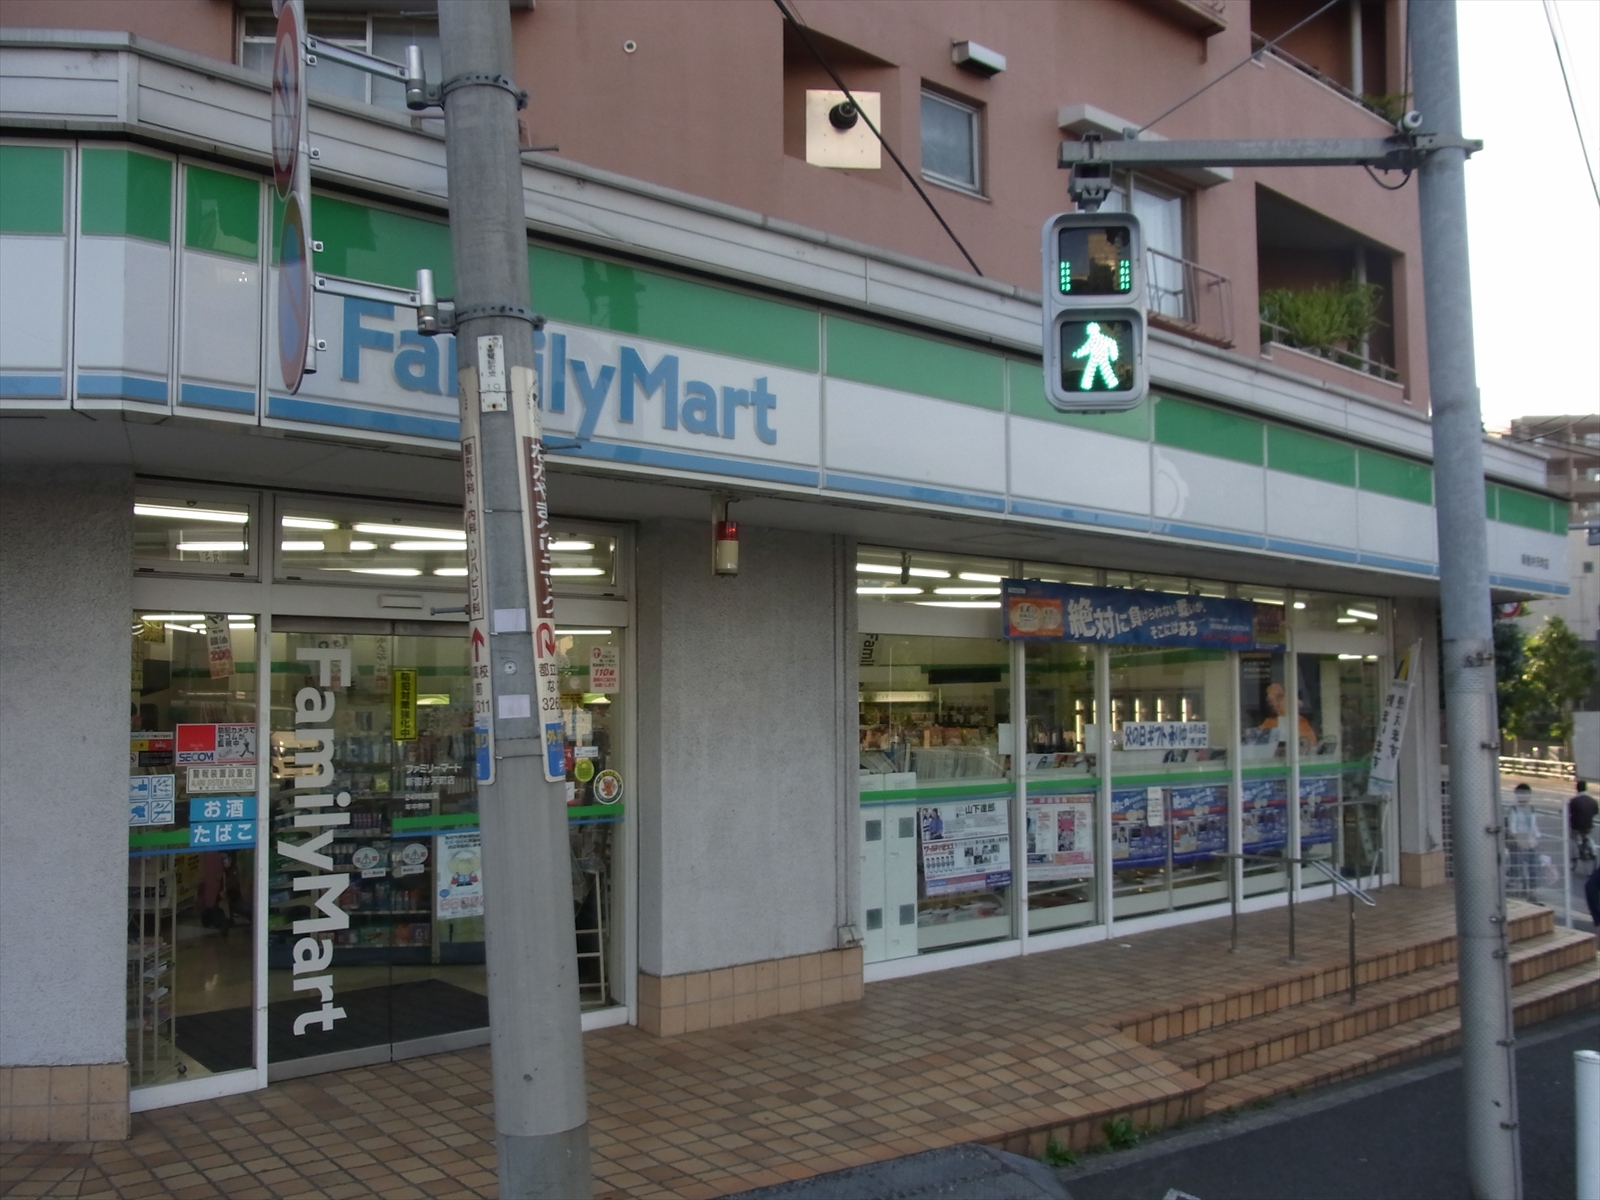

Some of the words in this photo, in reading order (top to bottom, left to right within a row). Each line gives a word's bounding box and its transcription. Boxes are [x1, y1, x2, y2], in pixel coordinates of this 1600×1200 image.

[179, 752, 214, 762] SECOM
[406, 763, 462, 774] ファミリーマート
[204, 800, 244, 818] お酒
[194, 824, 252, 843] たばこ
[277, 648, 352, 1036] FamilyMart
